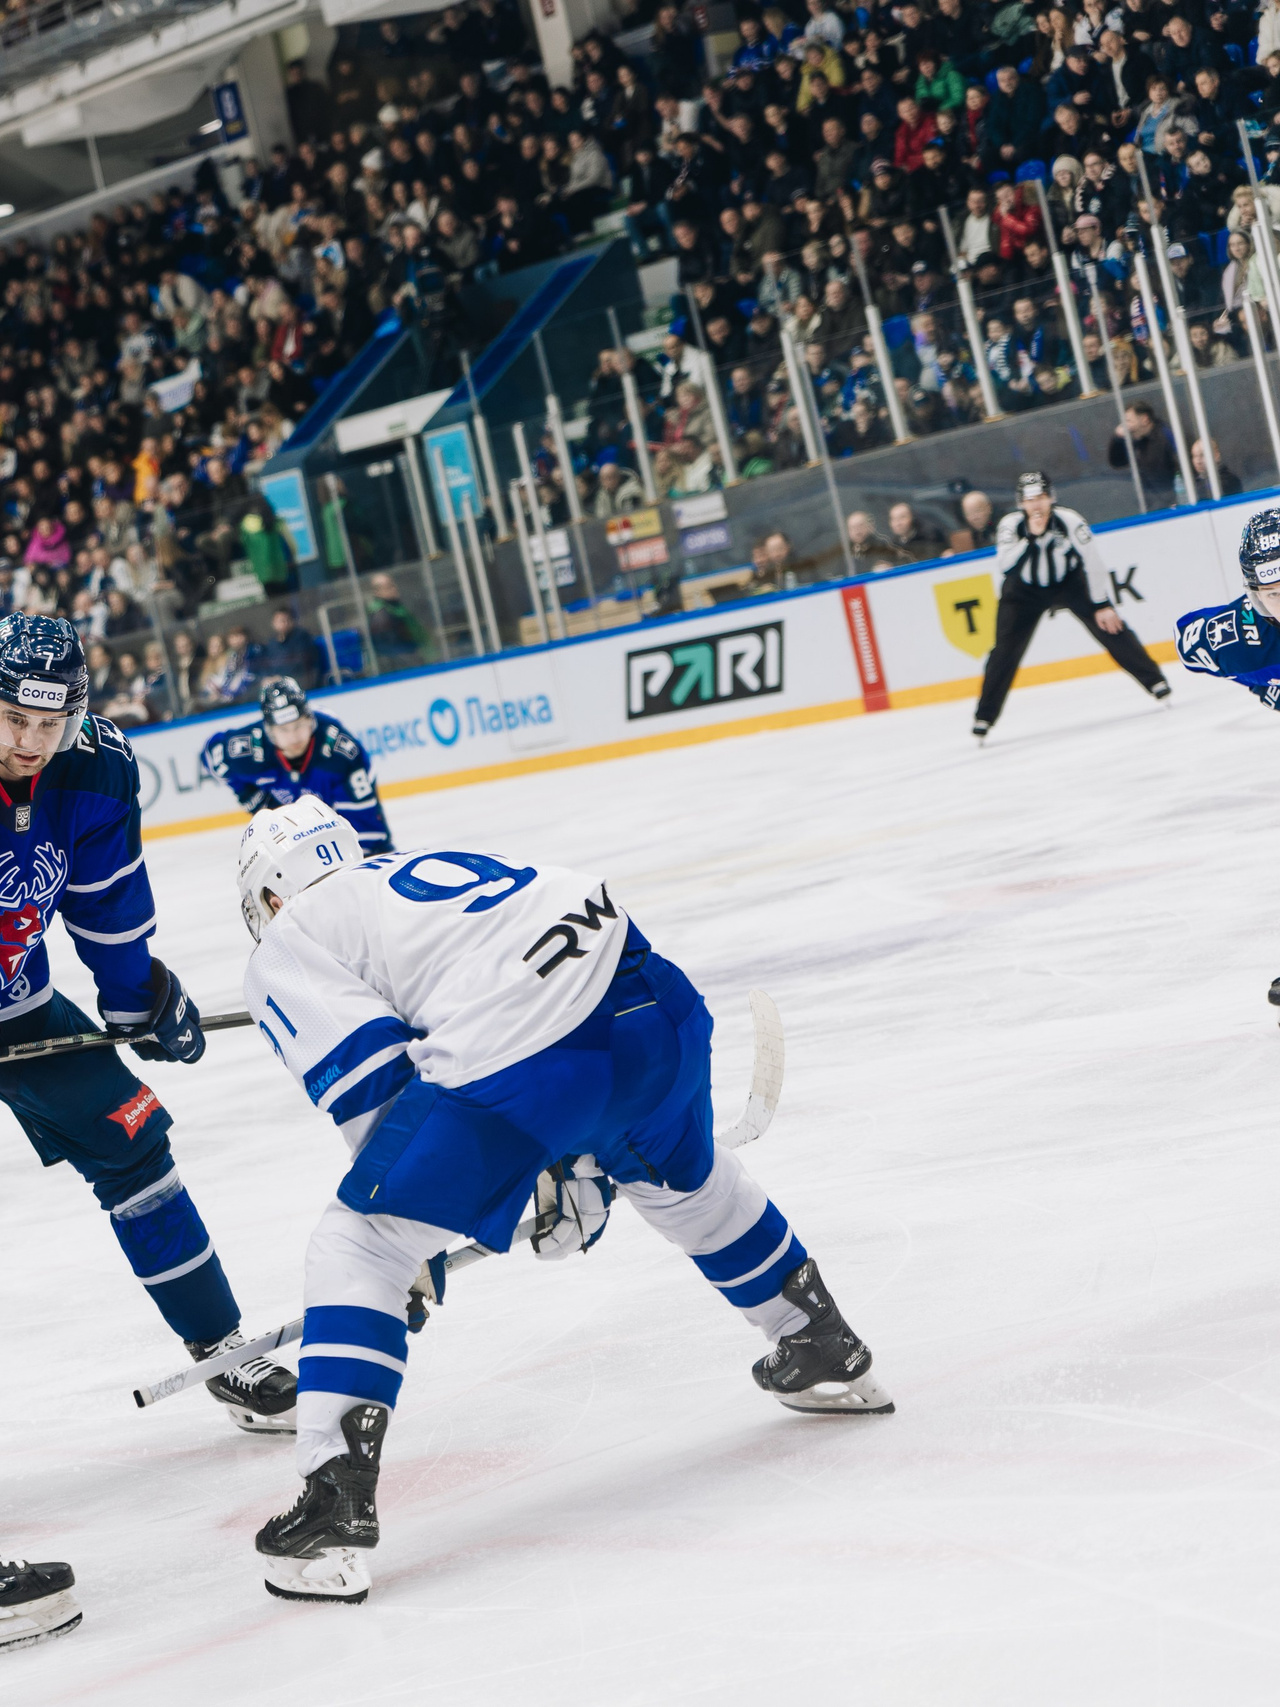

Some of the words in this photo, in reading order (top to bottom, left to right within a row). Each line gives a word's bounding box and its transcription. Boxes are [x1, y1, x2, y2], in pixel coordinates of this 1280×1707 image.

[1260, 566, 1280, 578] сог
[43, 651, 55, 671] 7
[629, 627, 781, 715] PARI
[22, 687, 64, 703] согаз
[357, 718, 427, 760] декс
[464, 693, 554, 738] Лавка
[316, 841, 344, 866] 91
[389, 851, 538, 914] 9
[308, 1064, 344, 1103] сква
[124, 1100, 148, 1124] Альфа
